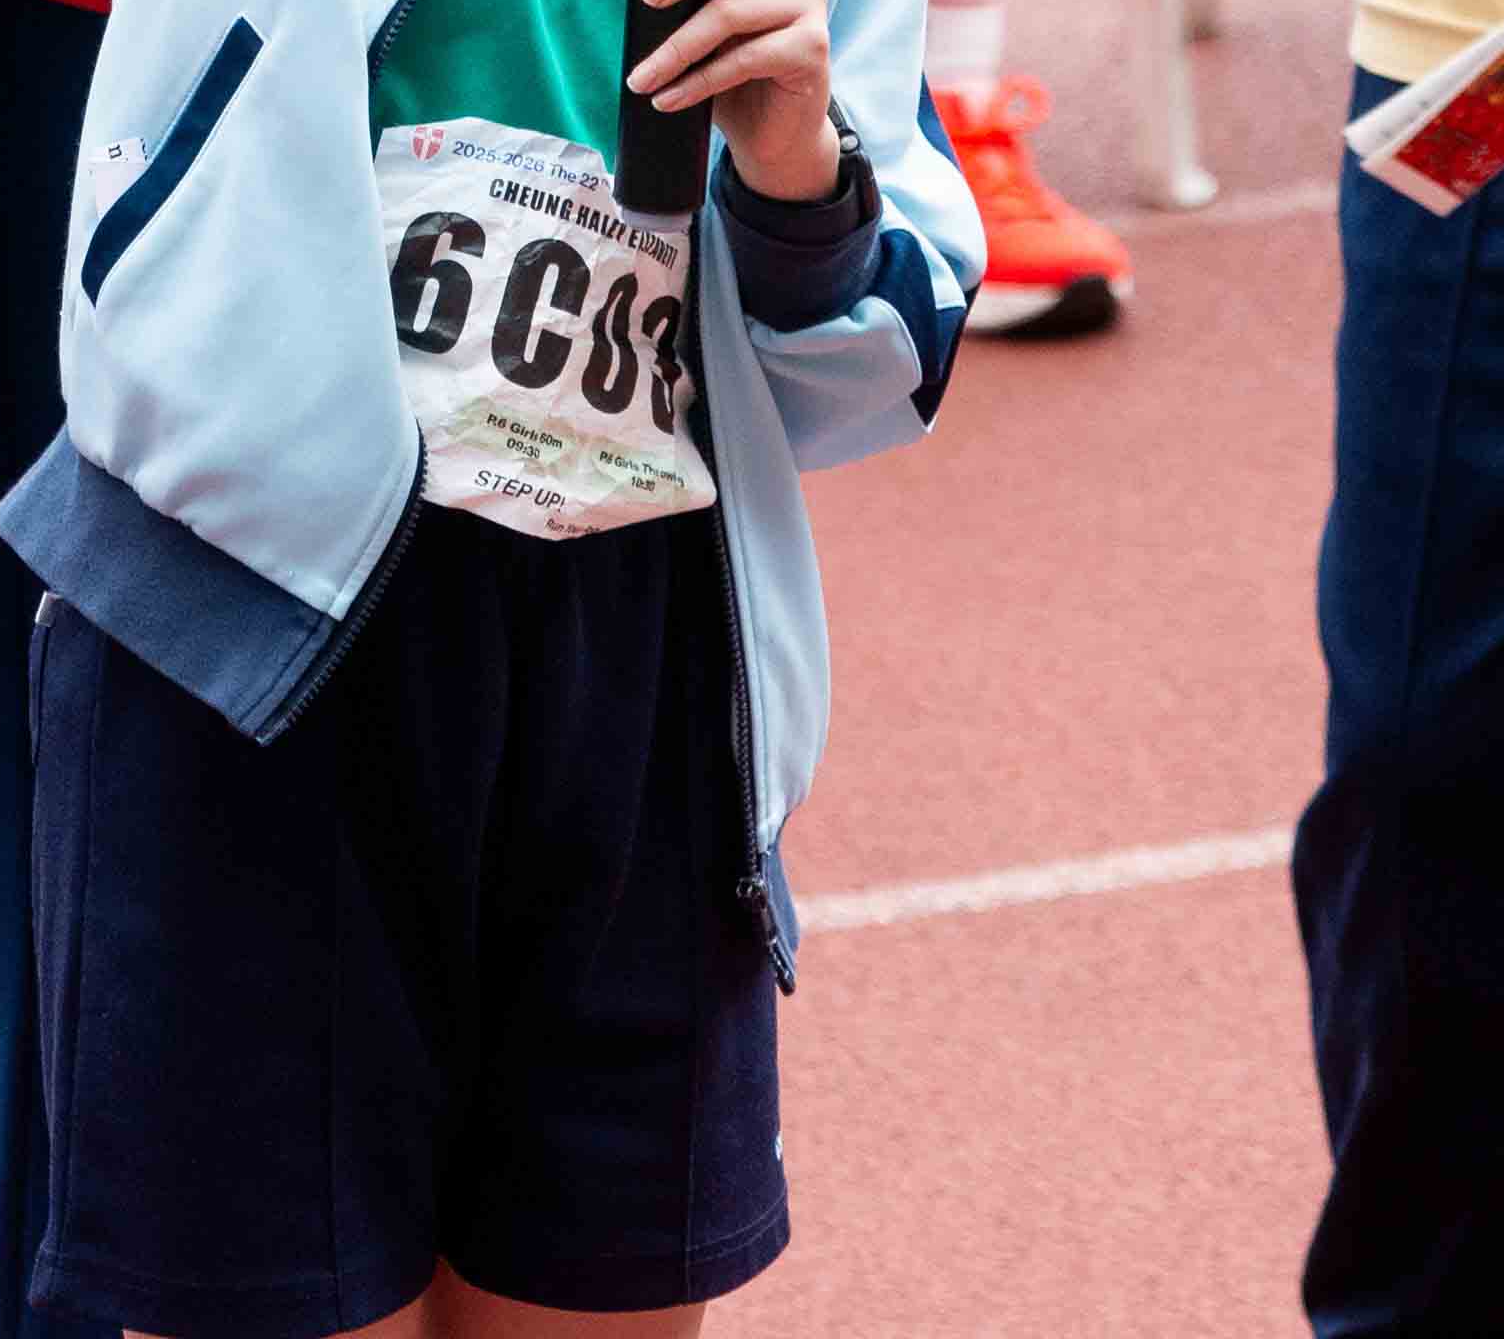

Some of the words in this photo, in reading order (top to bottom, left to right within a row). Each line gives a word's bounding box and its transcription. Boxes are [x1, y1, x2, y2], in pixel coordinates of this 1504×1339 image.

[452, 140, 545, 173] 2025-2026
[549, 162, 578, 184] The
[489, 178, 573, 222] CHEUNG
[506, 437, 541, 460] 09:30
[509, 422, 539, 442] Girls
[539, 432, 564, 450] 60m
[474, 470, 534, 500] STEP
[533, 488, 566, 513] UP!
